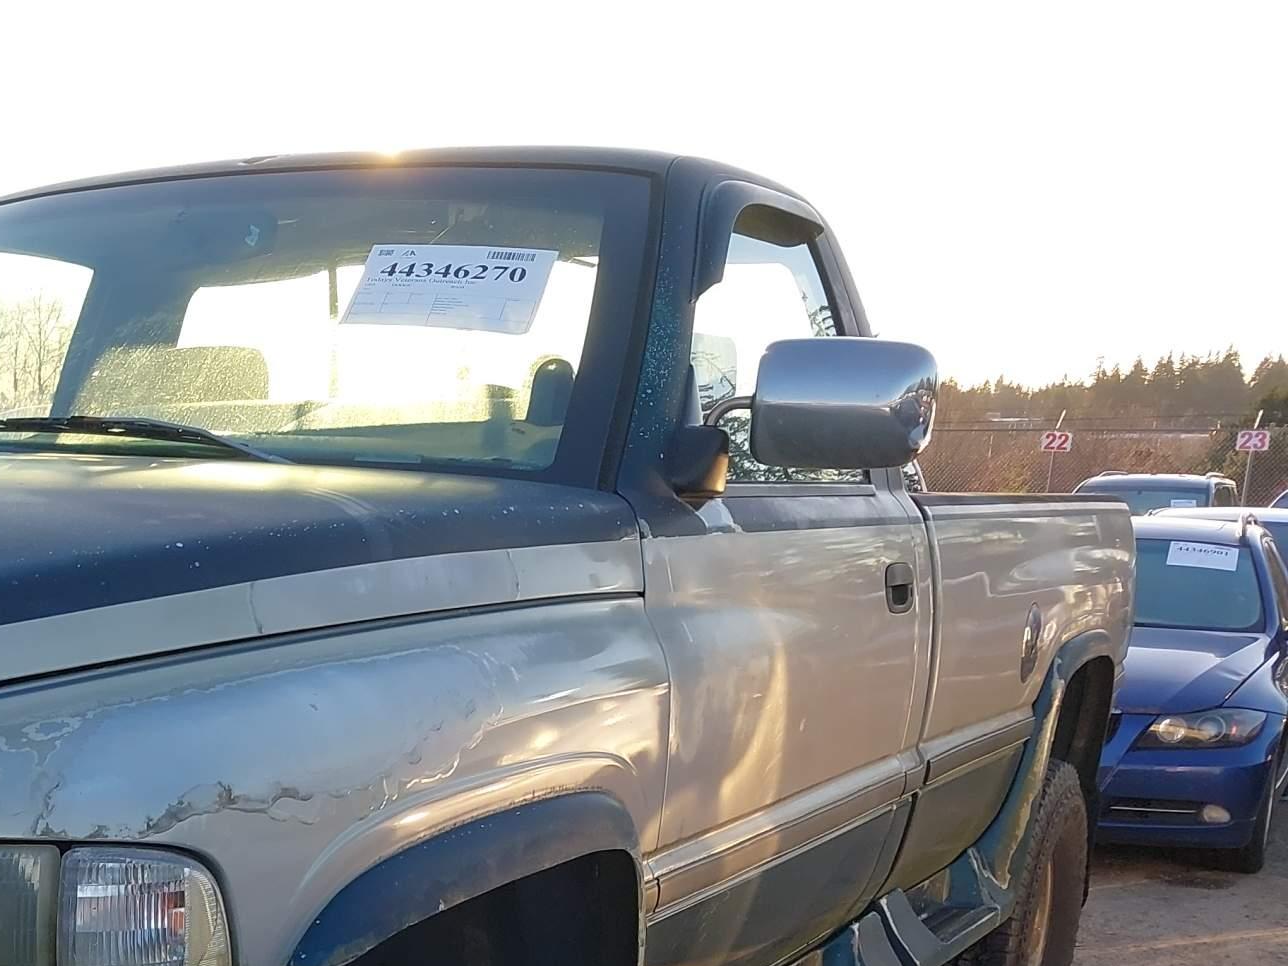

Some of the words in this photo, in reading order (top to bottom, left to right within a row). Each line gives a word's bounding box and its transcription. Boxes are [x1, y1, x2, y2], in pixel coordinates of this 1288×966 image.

[380, 262, 527, 283] 44346270
[1044, 433, 1069, 450] 22
[1239, 432, 1267, 450] 23
